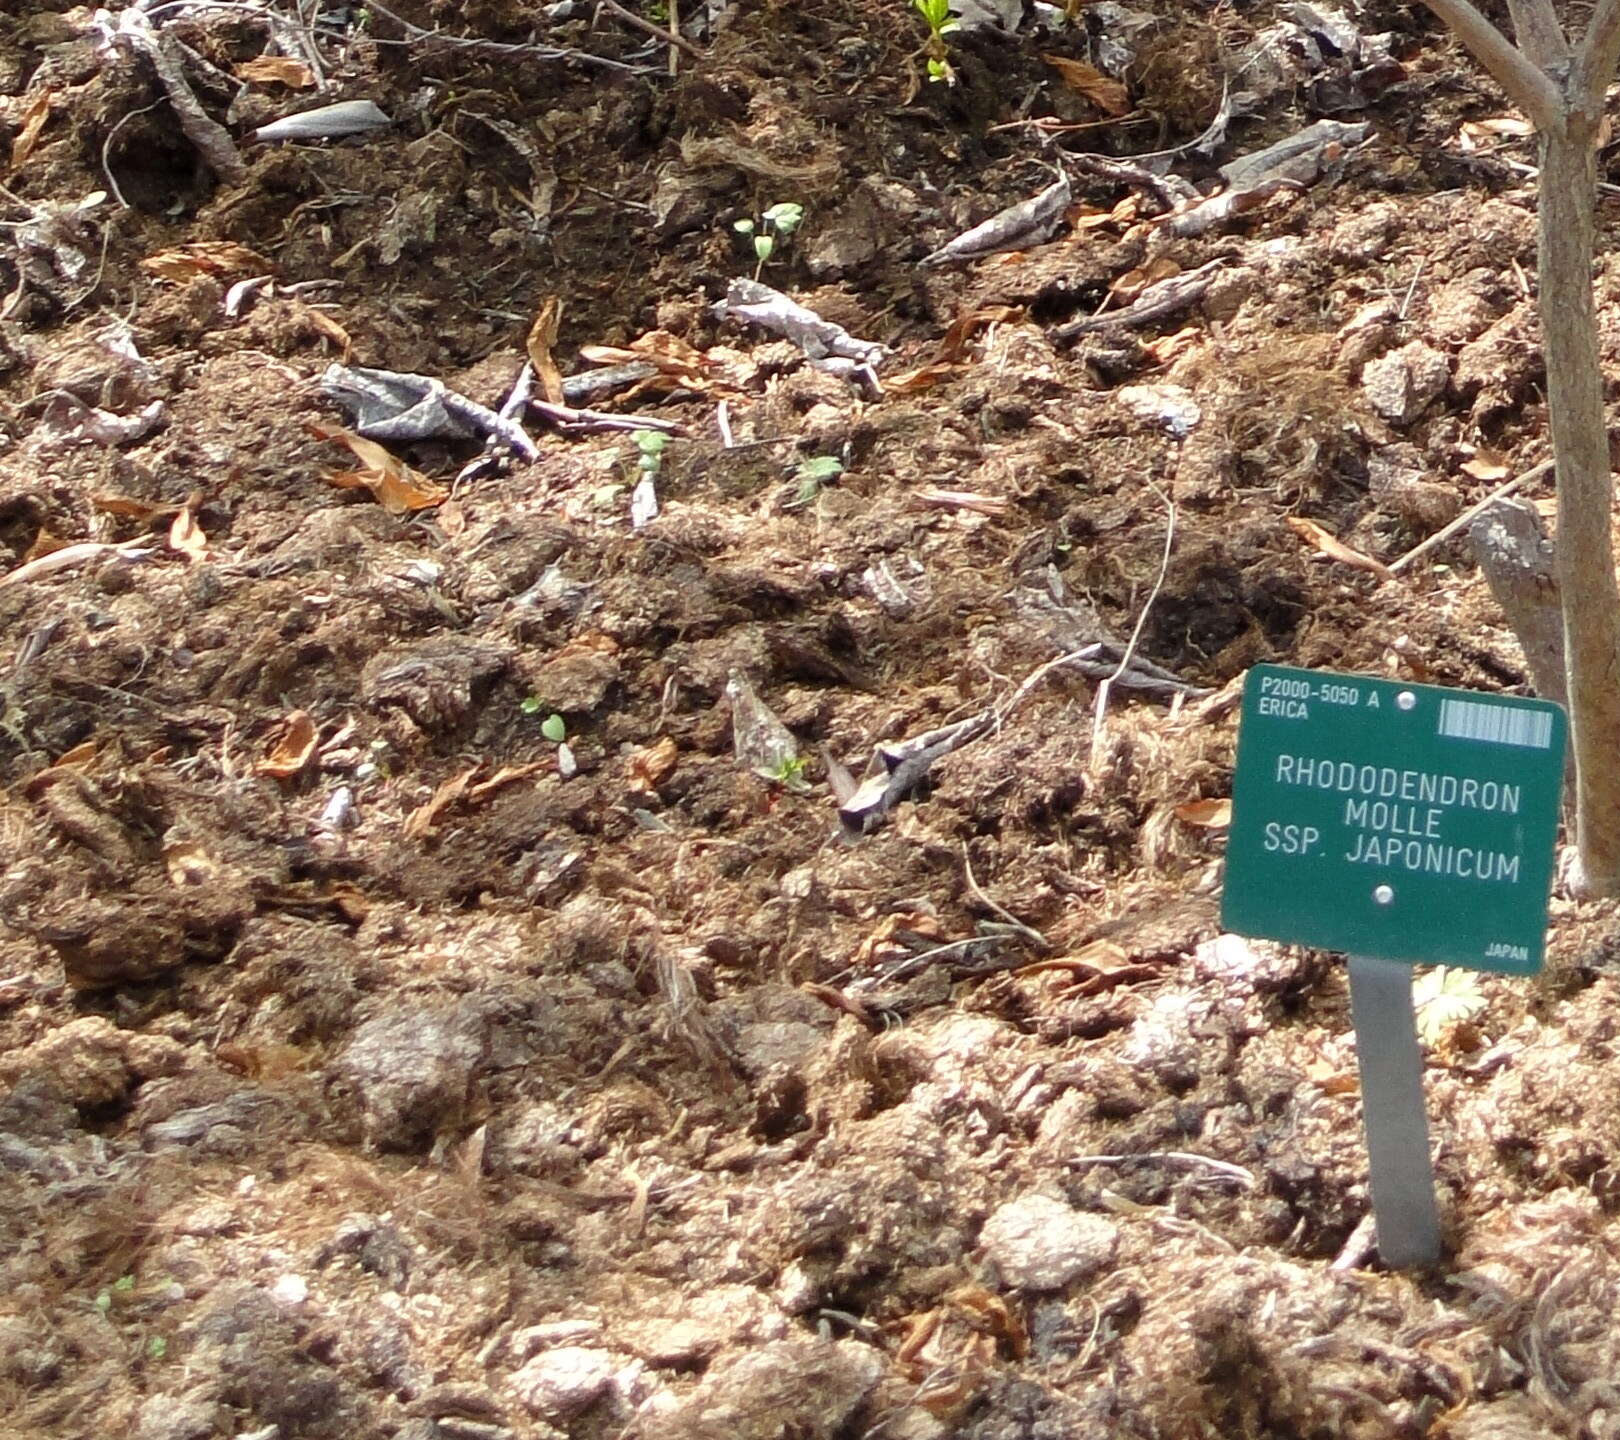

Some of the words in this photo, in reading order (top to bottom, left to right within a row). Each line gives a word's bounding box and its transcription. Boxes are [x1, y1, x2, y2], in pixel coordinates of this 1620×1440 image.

[1259, 696, 1309, 720] ERICA
[1260, 676, 1359, 706] P2000-5050
[1367, 689, 1380, 708] A
[1276, 754, 1521, 814] RHODODENDRON
[1344, 798, 1444, 839] MOLLE
[1263, 822, 1327, 858] SSP.
[1345, 833, 1520, 883] JAPONICUM
[1484, 942, 1529, 961] JAPAN
